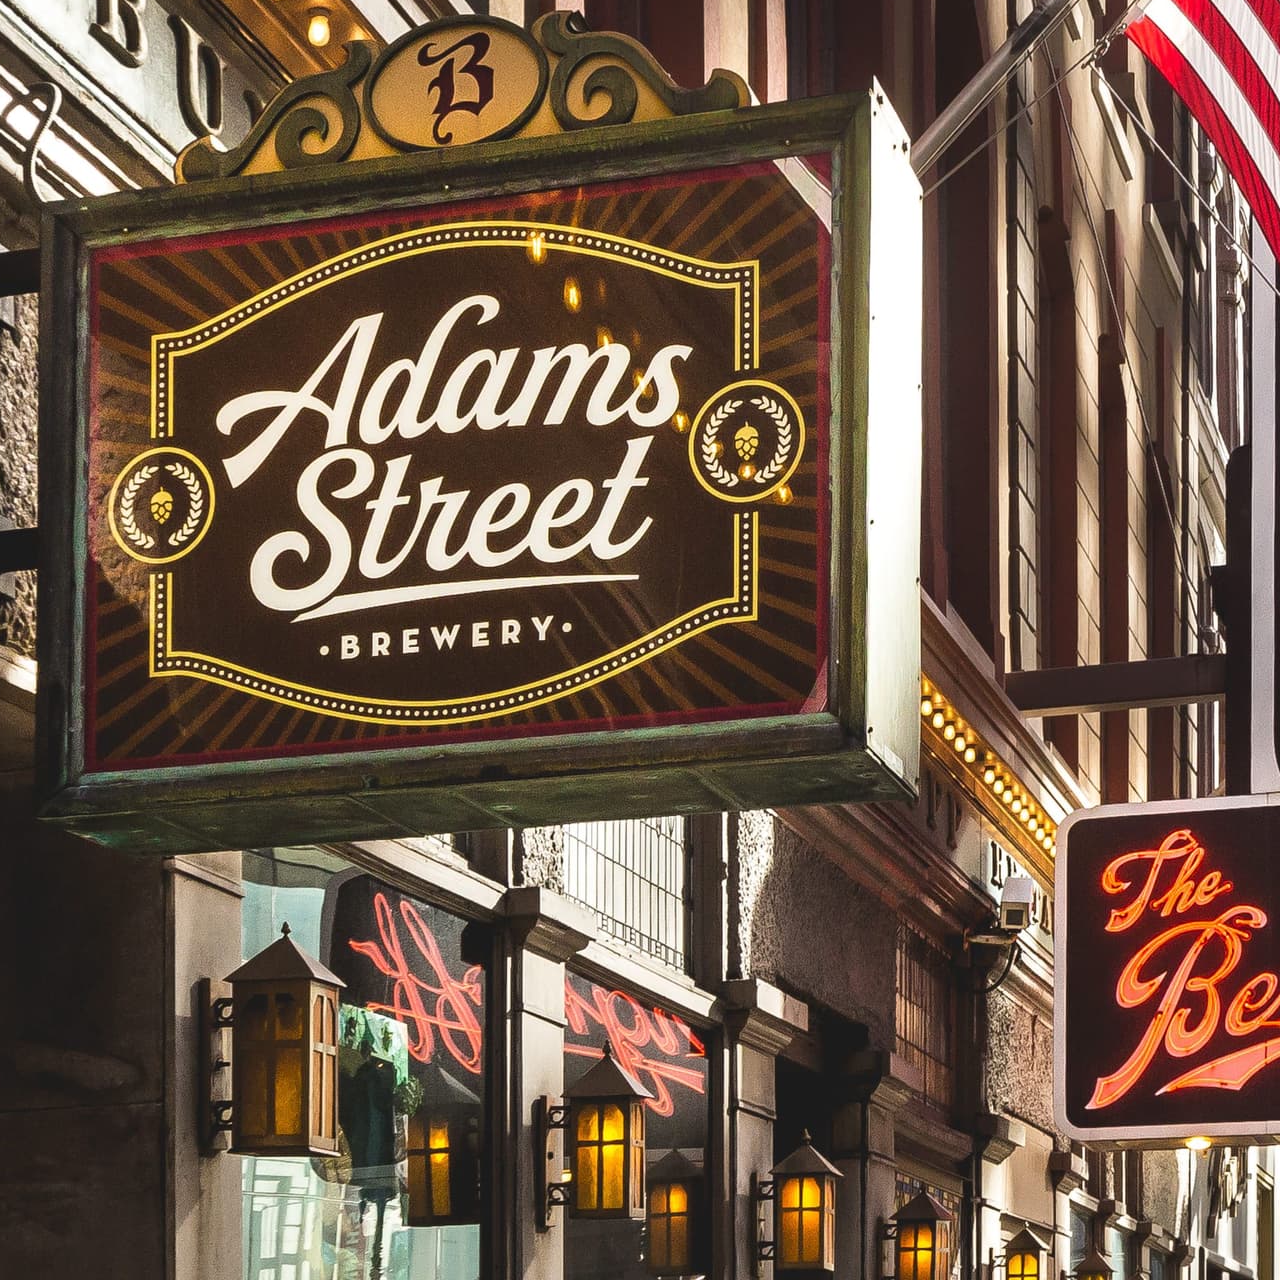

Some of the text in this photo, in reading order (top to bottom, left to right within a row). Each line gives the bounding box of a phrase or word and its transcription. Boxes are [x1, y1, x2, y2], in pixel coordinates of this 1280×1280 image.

[216, 294, 694, 490] Adams
[250, 435, 655, 624] Street
[339, 616, 555, 663] BREWERY
[1100, 827, 1235, 933] The
